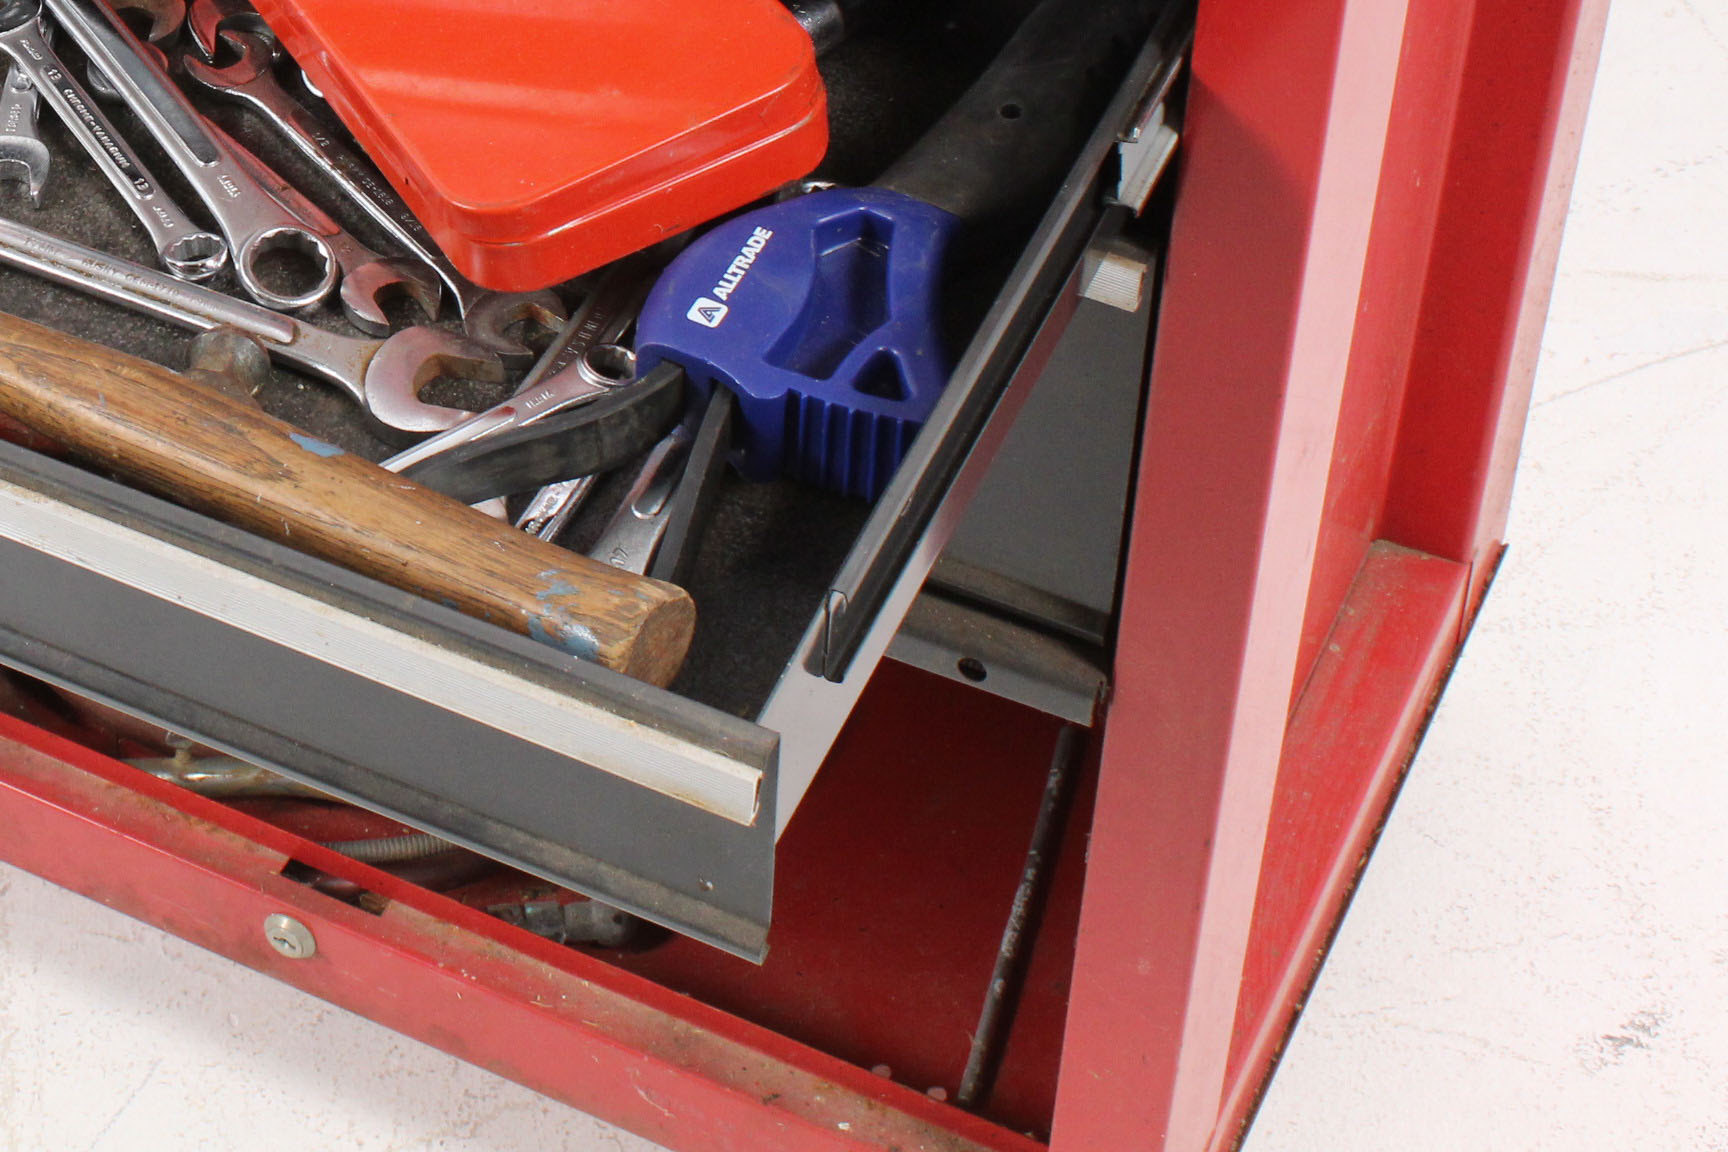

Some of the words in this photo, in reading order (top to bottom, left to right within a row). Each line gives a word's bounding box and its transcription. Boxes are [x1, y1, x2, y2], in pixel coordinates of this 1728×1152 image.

[47, 68, 62, 81] 13
[134, 177, 149, 191] 13
[712, 226, 773, 301] ALLTRADE
